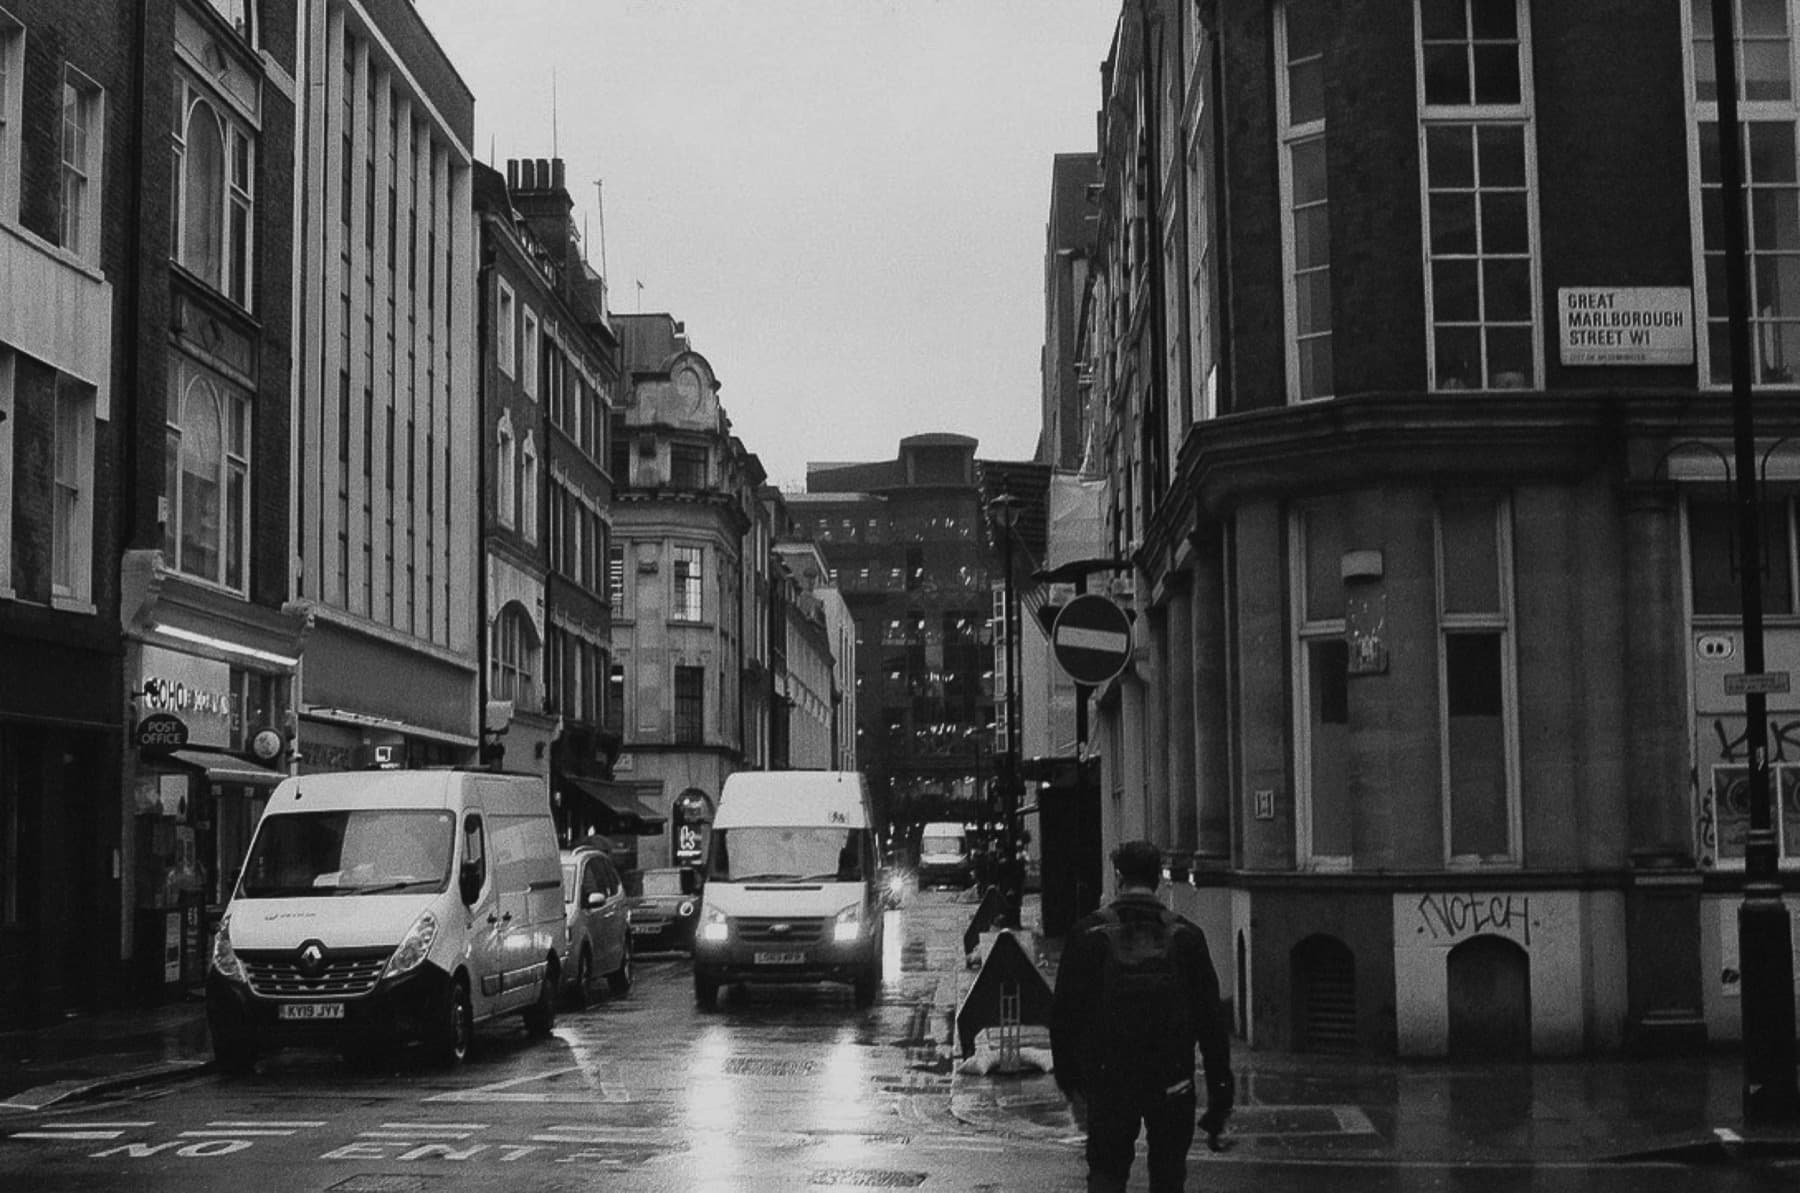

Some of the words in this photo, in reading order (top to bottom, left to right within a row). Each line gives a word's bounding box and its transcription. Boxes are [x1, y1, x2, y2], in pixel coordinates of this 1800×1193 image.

[1568, 293, 1614, 308] GREAT
[1568, 311, 1684, 327] MARLBOROUGH
[1569, 330, 1622, 345] STREET
[1630, 330, 1650, 345] W1
[148, 721, 177, 733] POST
[141, 732, 182, 745] OFFICE
[88, 1140, 254, 1157] NO
